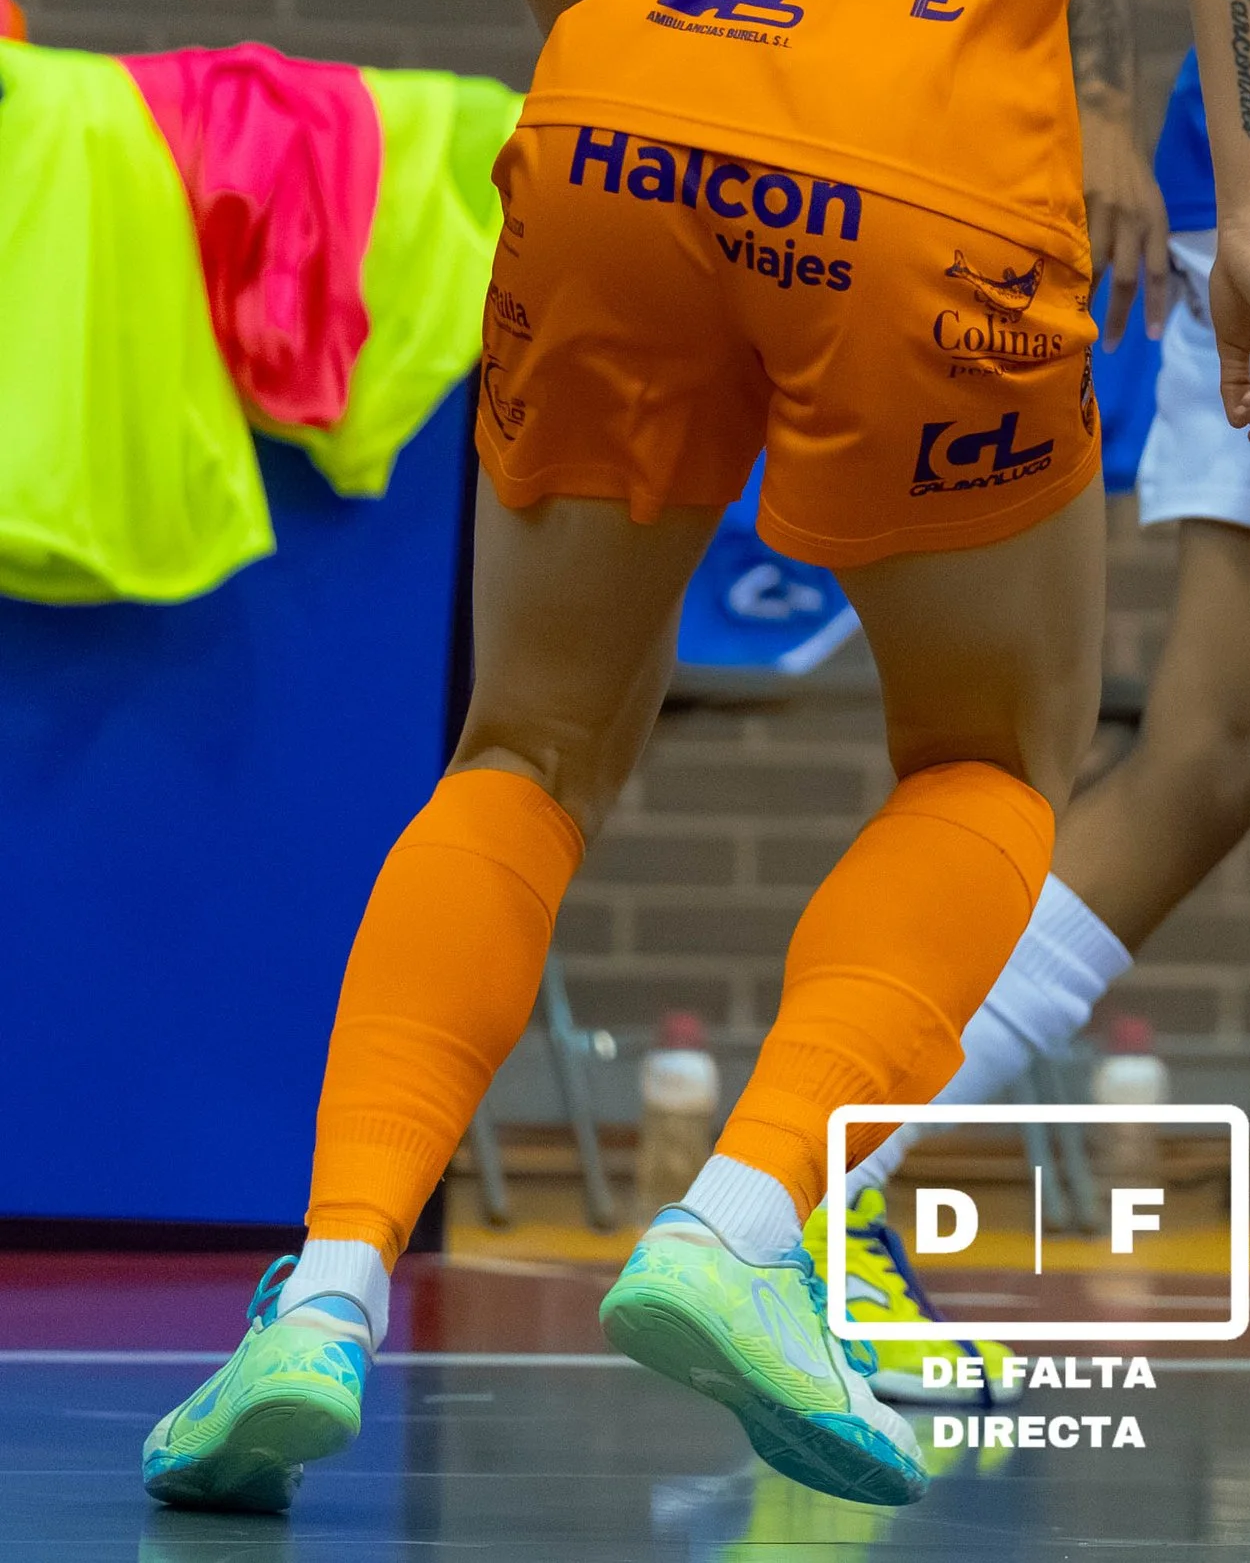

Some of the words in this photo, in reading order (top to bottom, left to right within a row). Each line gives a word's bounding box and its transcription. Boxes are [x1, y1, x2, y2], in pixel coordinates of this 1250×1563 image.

[646, 10, 725, 38] AMBULANCIAS
[569, 126, 864, 242] Halcon
[715, 230, 854, 292] viajes
[932, 309, 1063, 358] Colinas
